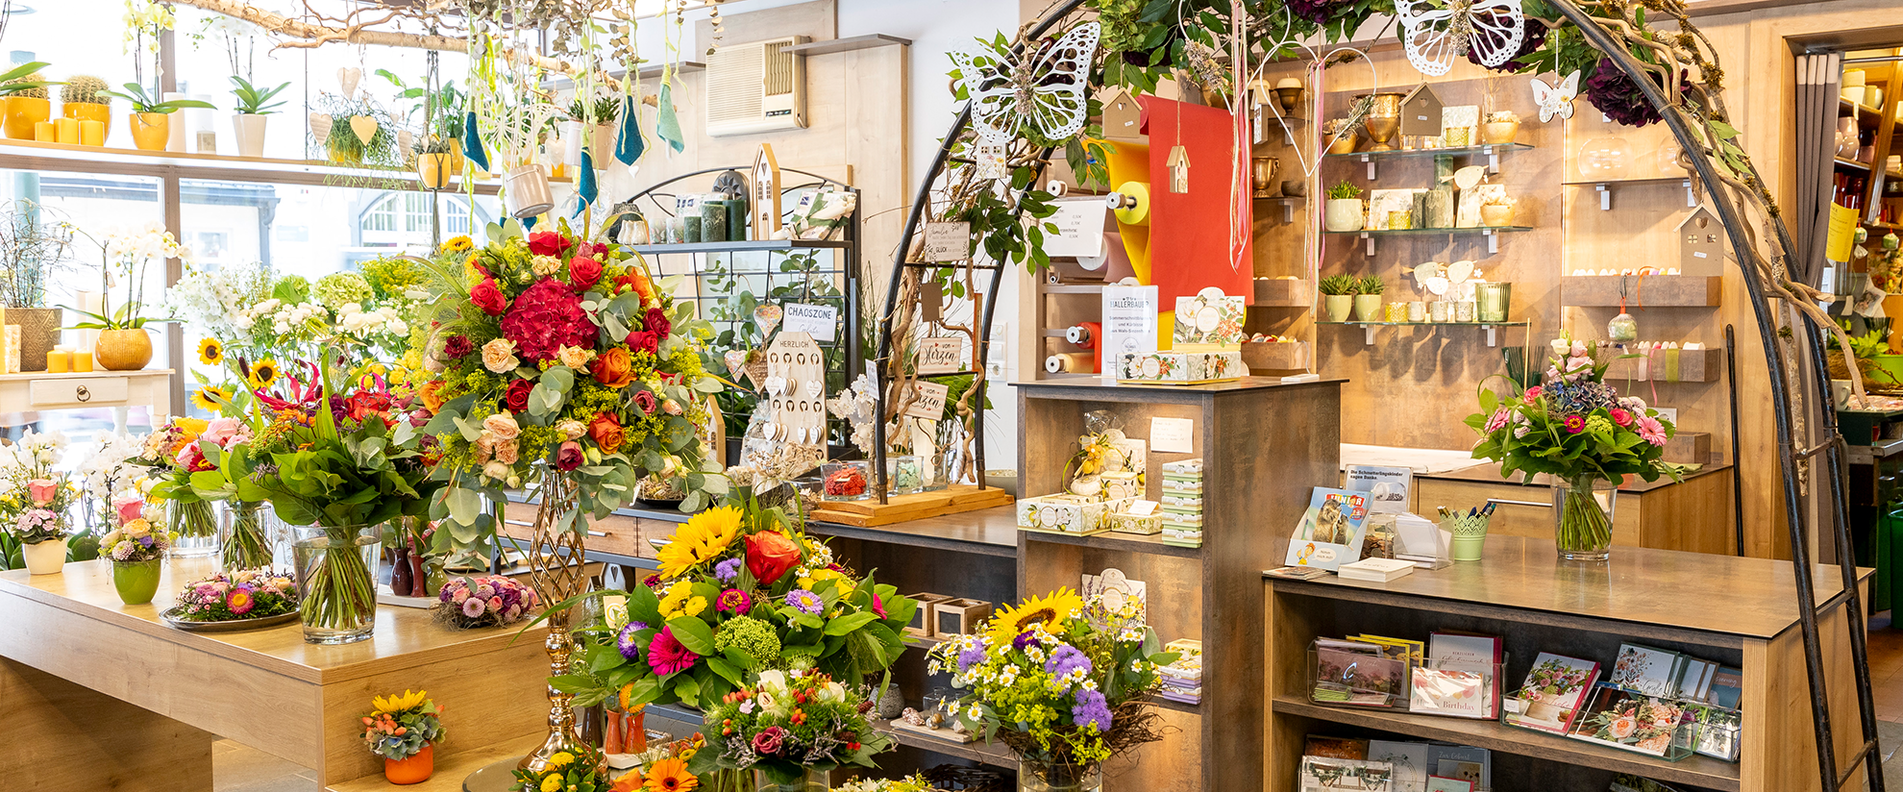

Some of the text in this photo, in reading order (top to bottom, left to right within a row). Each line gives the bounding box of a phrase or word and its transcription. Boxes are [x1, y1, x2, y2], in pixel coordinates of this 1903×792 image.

[788, 307, 832, 320] CHAOSZONE
[779, 340, 809, 348] HERZLICH
[922, 345, 957, 366] Herzen
[1443, 701, 1475, 712] Birthday
[1439, 751, 1470, 760] Zur Geburt
